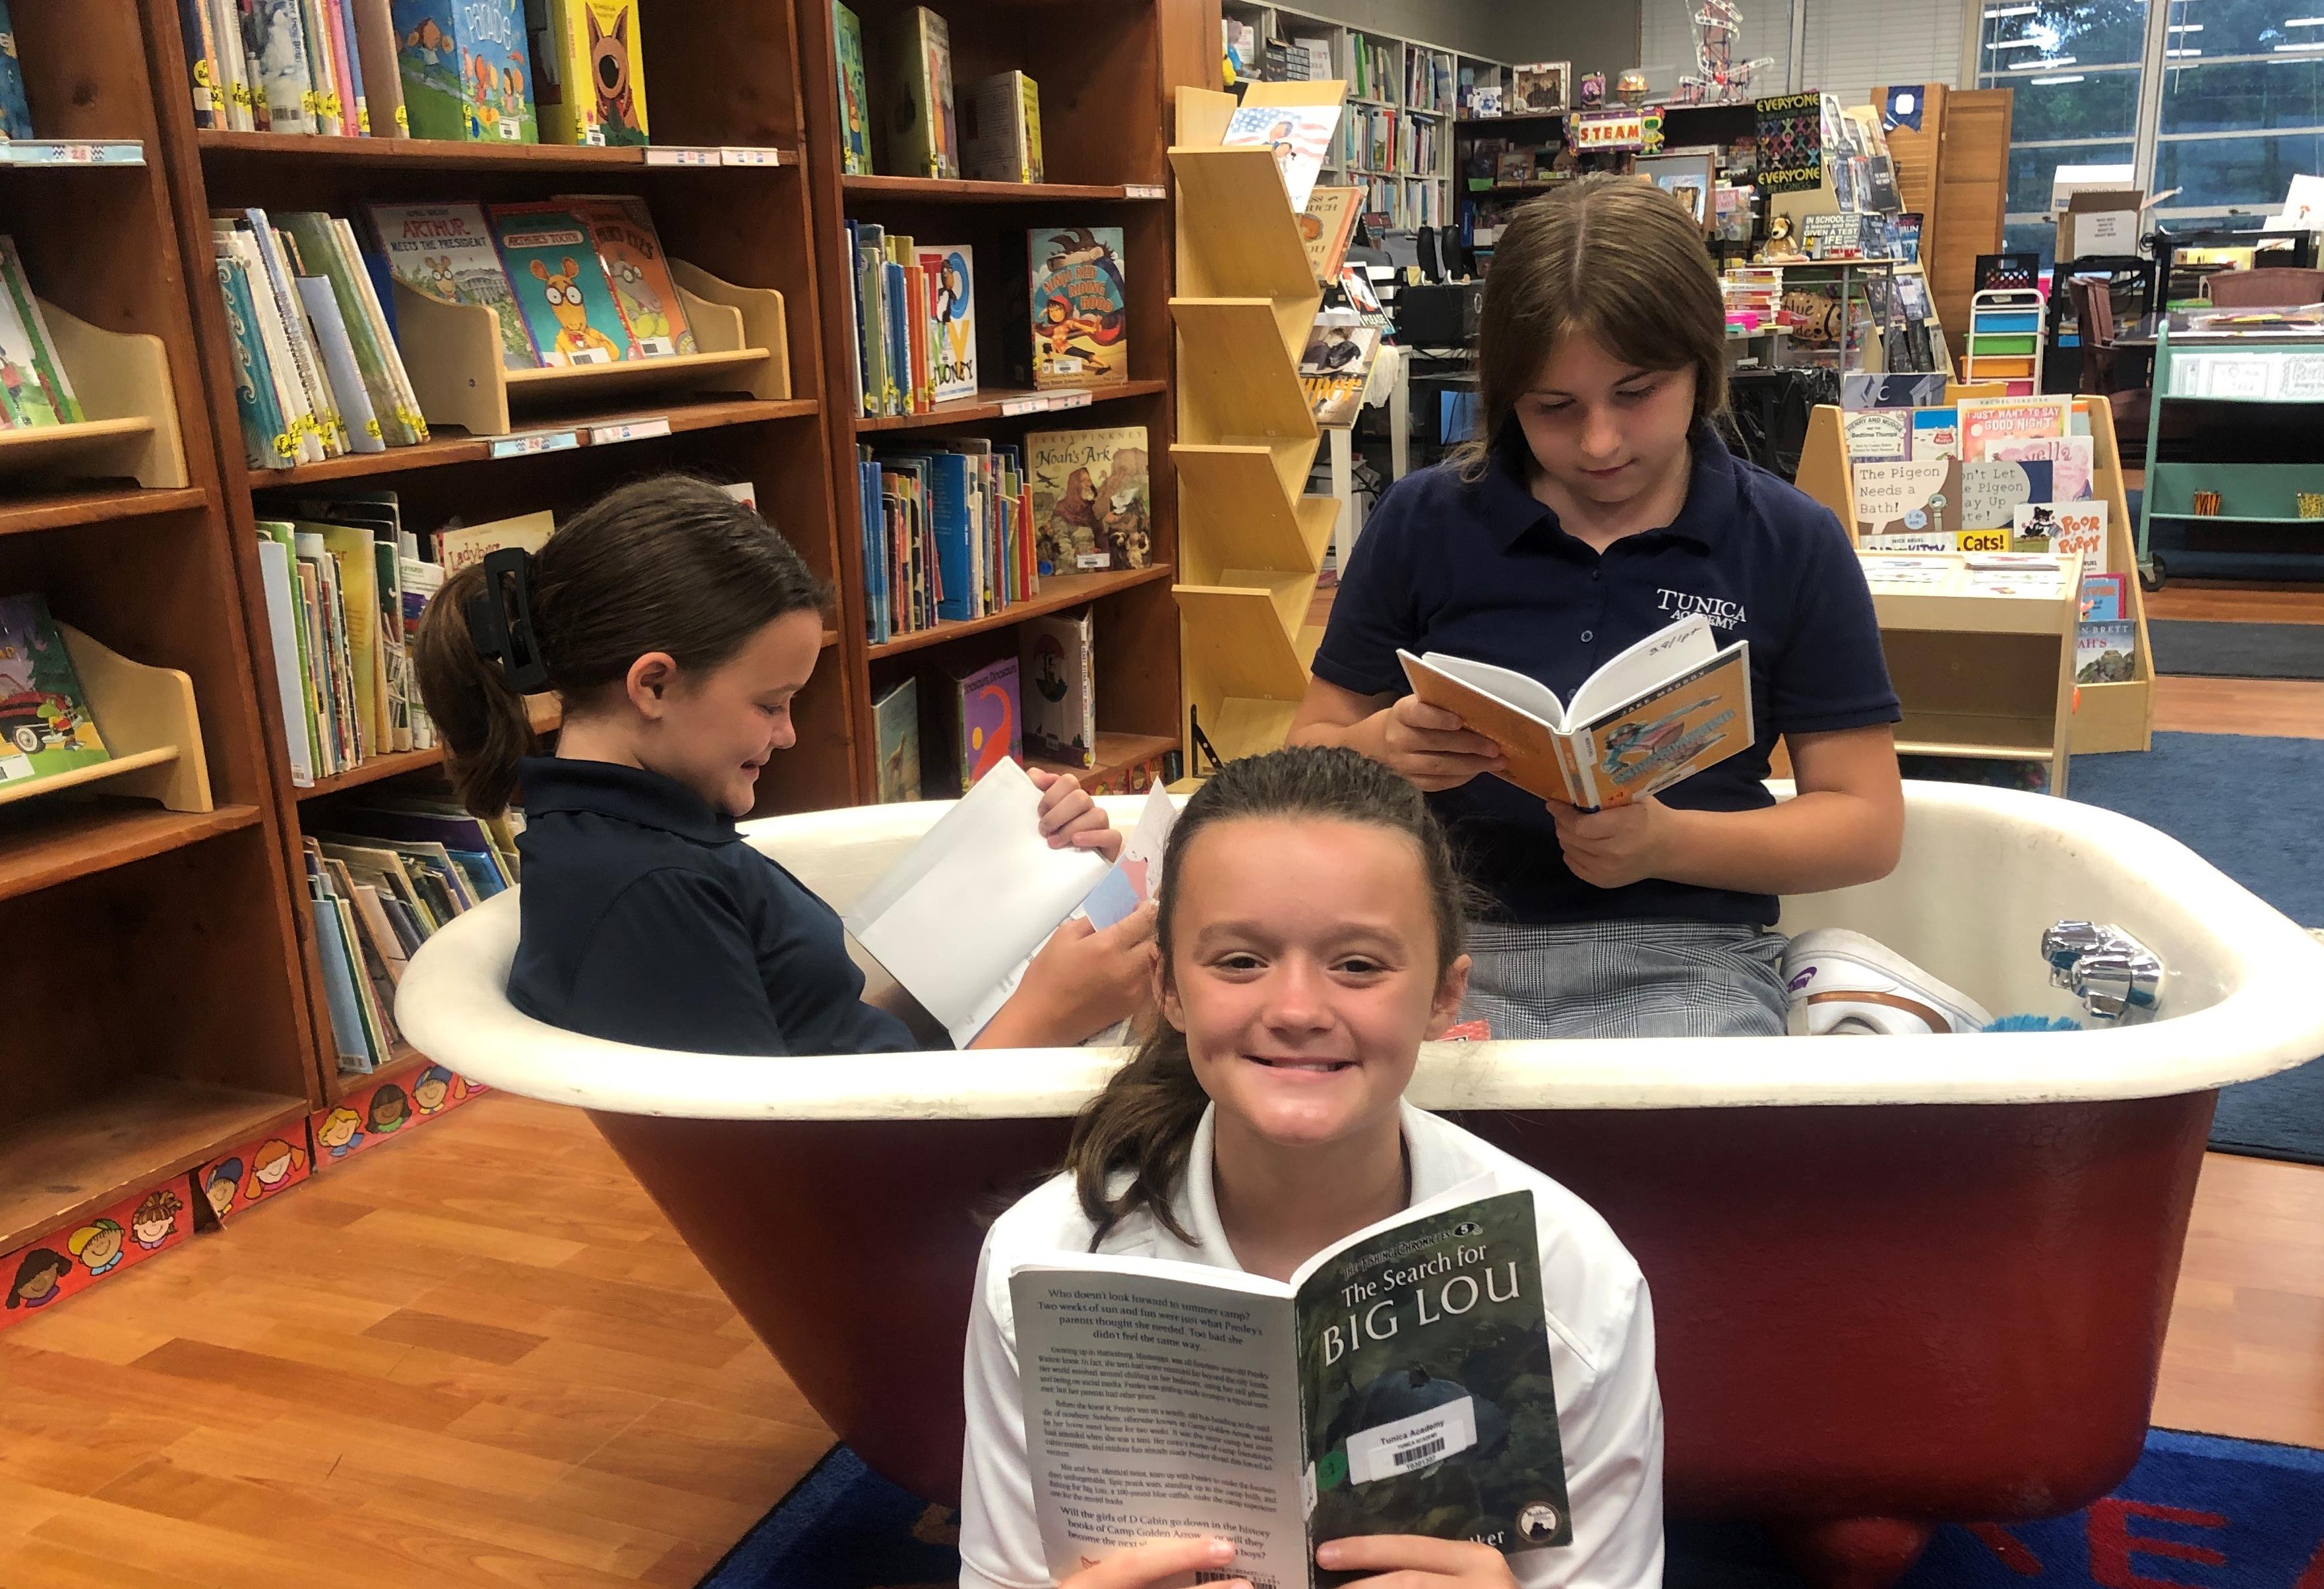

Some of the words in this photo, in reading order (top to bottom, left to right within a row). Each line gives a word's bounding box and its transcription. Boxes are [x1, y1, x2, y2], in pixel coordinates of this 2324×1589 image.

[1756, 94, 1819, 113] EVERYONE
[1580, 124, 1640, 142] STEAM
[1758, 166, 1820, 185] EVERYONE
[403, 218, 471, 239] ARTHUR
[1815, 215, 1845, 224] SCHOOL
[1824, 235, 1843, 245] IFE
[1837, 227, 1857, 236] TEST
[438, 237, 487, 249] PRESIDENT
[1043, 268, 1074, 295] NINJA
[1076, 264, 1097, 279] RED
[1068, 280, 1106, 297] RIDING
[1080, 295, 1113, 313] HOOD
[1971, 410, 1997, 419] JUST
[1998, 409, 2024, 417] WANT
[2042, 407, 2060, 416] SAY
[1847, 419, 1867, 432] HENRY
[1984, 419, 2013, 431] GOOD
[2017, 417, 2054, 430] NIGHT
[1082, 431, 1144, 442] PINKNEY
[1035, 441, 1080, 469] Noah's
[1081, 444, 1112, 466] Ark
[1860, 467, 1885, 481] The
[1891, 466, 1940, 479] Pigeon
[1993, 467, 2015, 479] Let
[1860, 485, 1903, 497] Needs
[1908, 485, 1916, 495] a
[1978, 482, 2024, 496] Pigeon
[1860, 502, 1899, 514] Bath!
[1988, 496, 2007, 508] Up
[2061, 515, 2100, 535] POOR
[1963, 534, 2004, 551] Cats!
[2058, 535, 2101, 555] PUPPY
[1657, 588, 1747, 622] TUNICA
[2092, 625, 2129, 634] BRETT
[989, 663, 1018, 684] Dinosaurs
[1461, 1224, 1469, 1234] 5
[1341, 1280, 1378, 1308] The
[1383, 1251, 1452, 1292] Search
[1456, 1244, 1486, 1267] for
[1047, 1288, 1072, 1299] Who
[1074, 1290, 1107, 1301] doesn't
[1109, 1292, 1130, 1302] look
[1131, 1293, 1167, 1307] forward
[1169, 1300, 1180, 1309] to
[1180, 1303, 1217, 1316] summer
[1219, 1310, 1252, 1322] camp?
[1323, 1299, 1399, 1367] BIG
[1416, 1261, 1521, 1327] LOU
[1038, 1301, 1058, 1311] Two
[1058, 1302, 1087, 1311] weeks
[1088, 1302, 1100, 1312] of
[1119, 1307, 1138, 1316] and
[1140, 1308, 1157, 1318] fun
[1159, 1311, 1180, 1320] were
[1200, 1317, 1222, 1330] what
[1224, 1321, 1264, 1336] Presley's
[1058, 1317, 1094, 1327] parents
[1095, 1317, 1133, 1330] thought
[1134, 1320, 1150, 1330] she
[1151, 1322, 1187, 1336] needed.
[1189, 1327, 1207, 1339] Too
[1208, 1330, 1226, 1342] bad
[1227, 1334, 1245, 1346] she
[1092, 1329, 1120, 1340] didn't
[1122, 1331, 1139, 1342] feel
[1140, 1334, 1155, 1344] the
[1156, 1337, 1180, 1347] same
[1381, 1433, 1408, 1445] Tunica
[1410, 1420, 1444, 1437] Academy
[1060, 1505, 1079, 1517] Will
[1081, 1509, 1095, 1519] the
[1095, 1513, 1116, 1523] girls
[1116, 1514, 1126, 1524] of
[1129, 1514, 1138, 1524] D
[1140, 1516, 1168, 1526] Cabin
[1170, 1518, 1182, 1528] go
[1183, 1517, 1209, 1528] down
[1211, 1520, 1221, 1530] in
[1222, 1522, 1238, 1532] the
[1238, 1524, 1271, 1540] history
[1067, 1518, 1095, 1530] books
[1095, 1524, 1105, 1533] of
[1107, 1524, 1134, 1538] Camp
[1136, 1528, 1171, 1538] Golden
[1226, 1534, 1243, 1544] will
[1244, 1536, 1265, 1549] they
[1067, 1530, 1101, 1544] become
[1102, 1536, 1116, 1547] the
[1117, 1539, 1139, 1549] next
[1240, 1549, 1266, 1561] boys?
